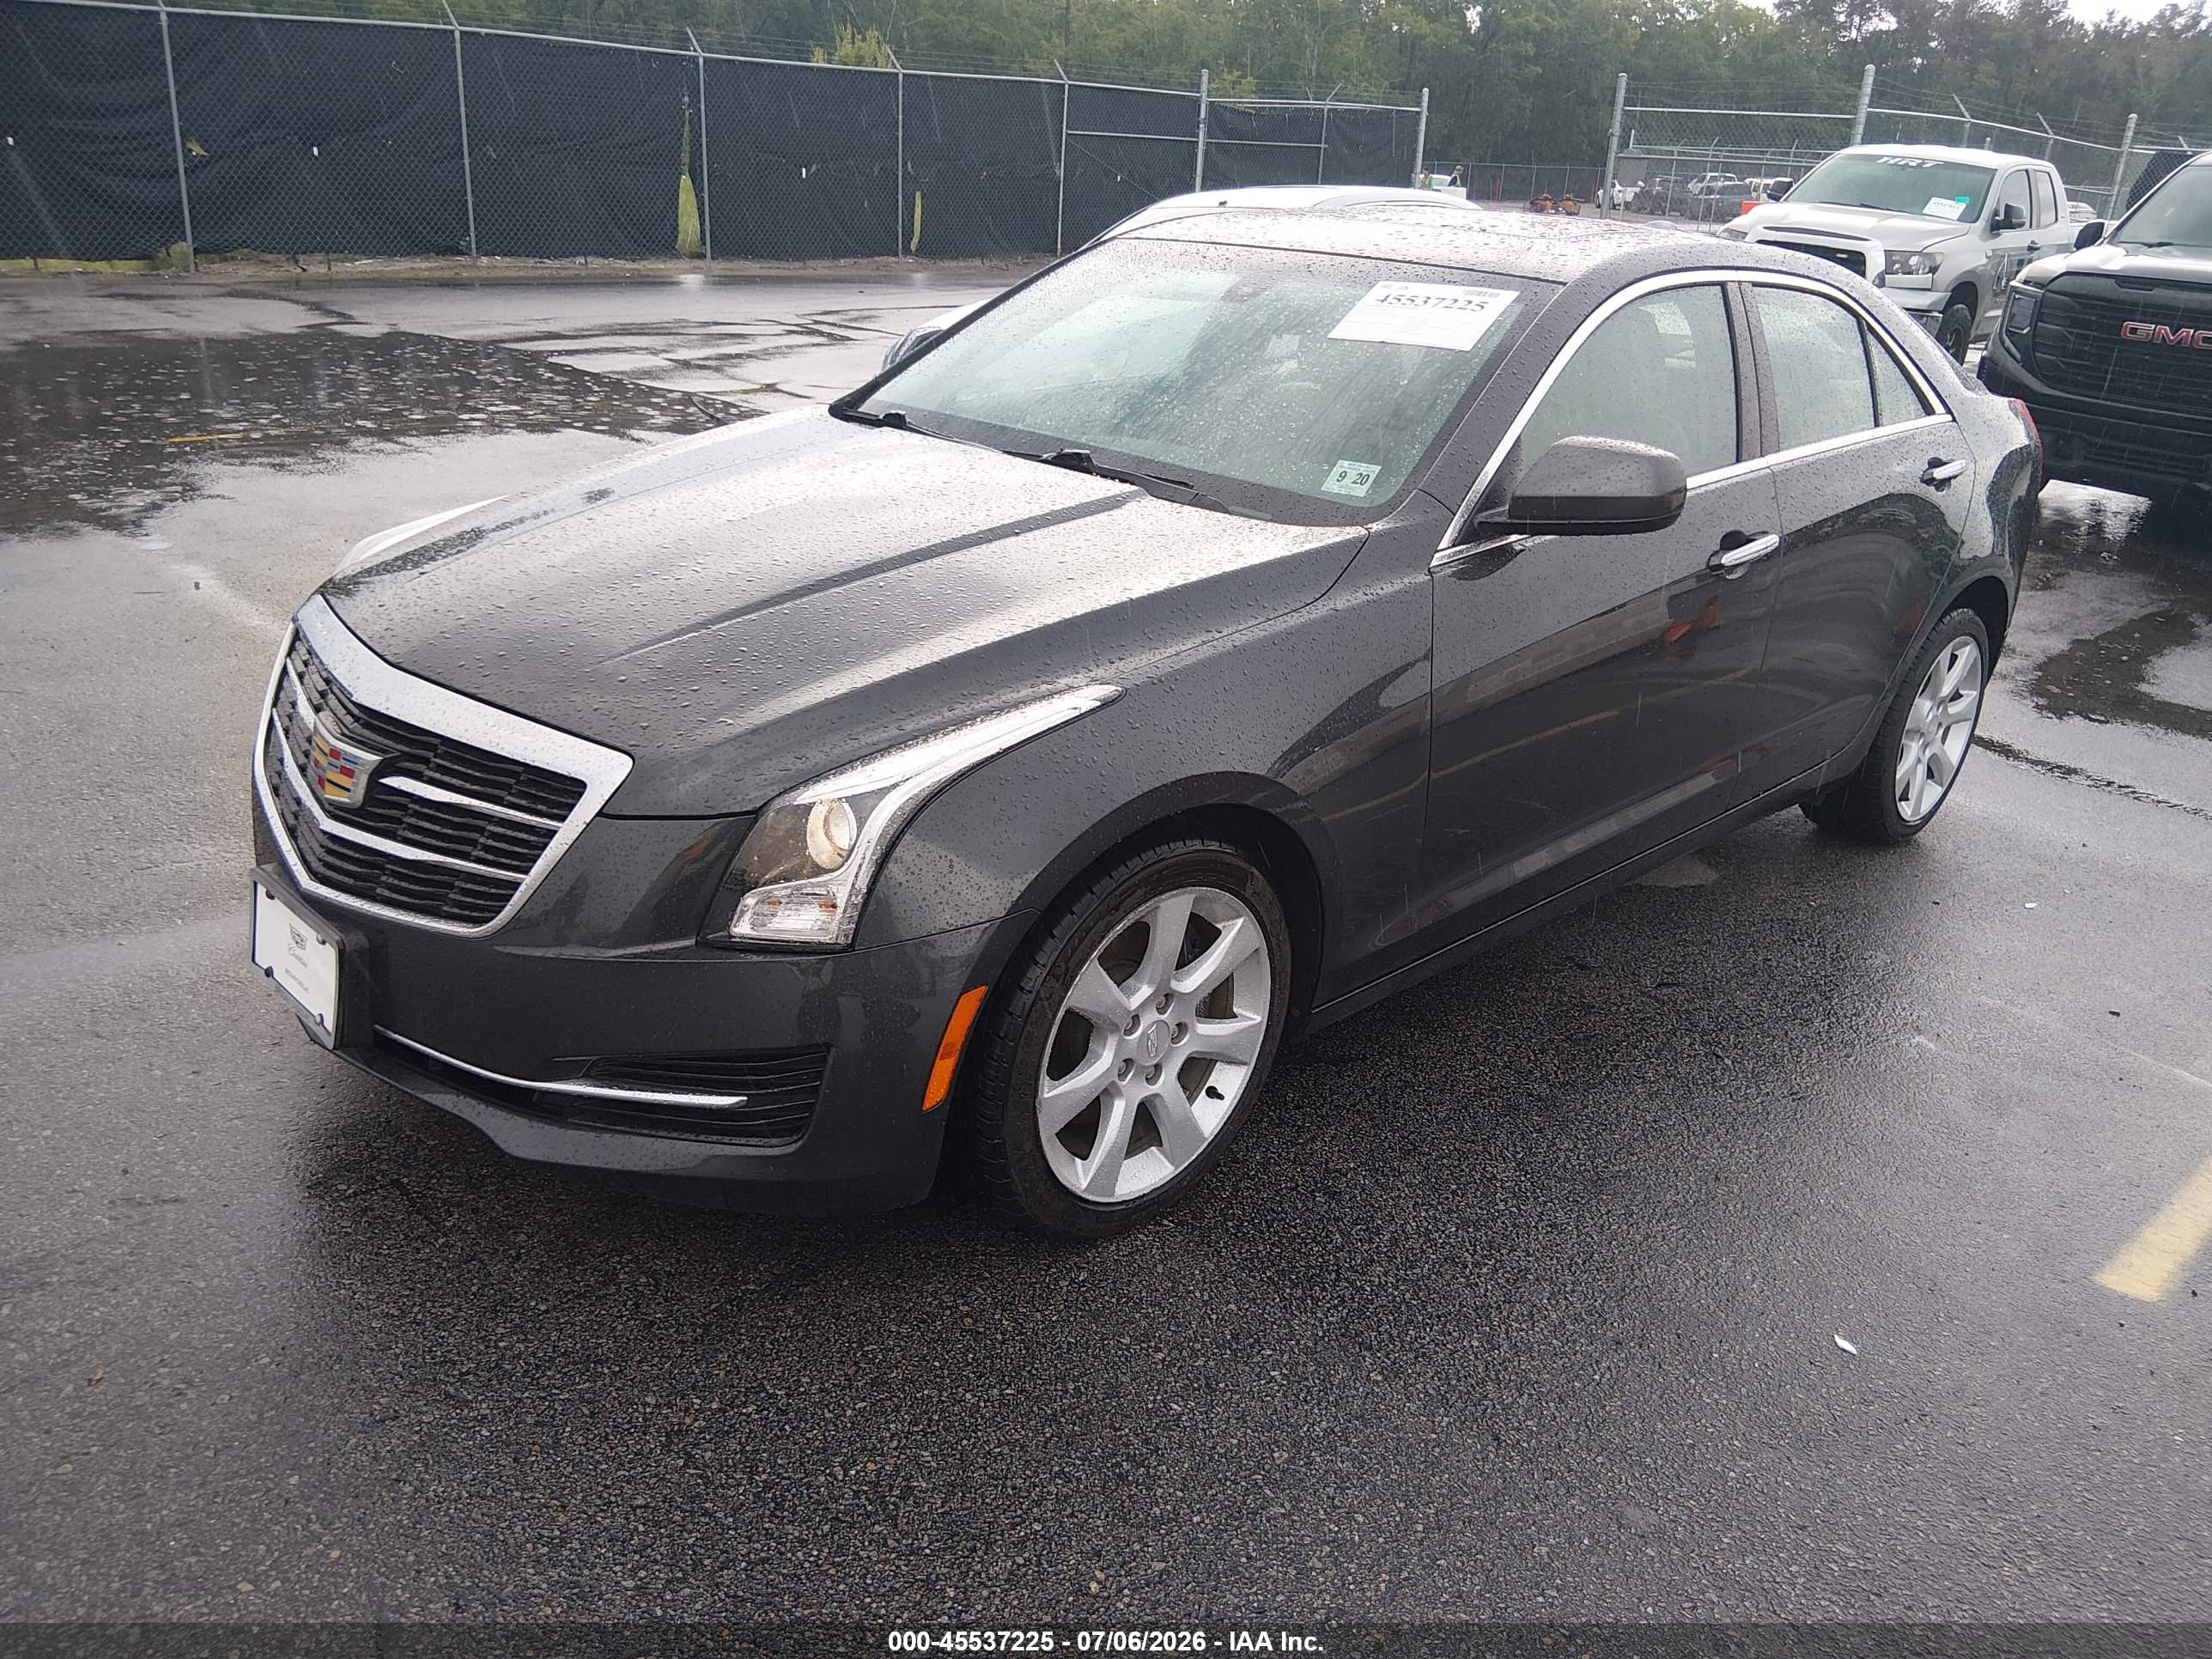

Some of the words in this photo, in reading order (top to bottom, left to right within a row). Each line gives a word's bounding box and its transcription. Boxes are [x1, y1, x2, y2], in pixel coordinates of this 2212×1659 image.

[1376, 294, 1490, 312] 45537225
[1336, 470, 1347, 483] 9
[1351, 472, 1370, 486] 20
